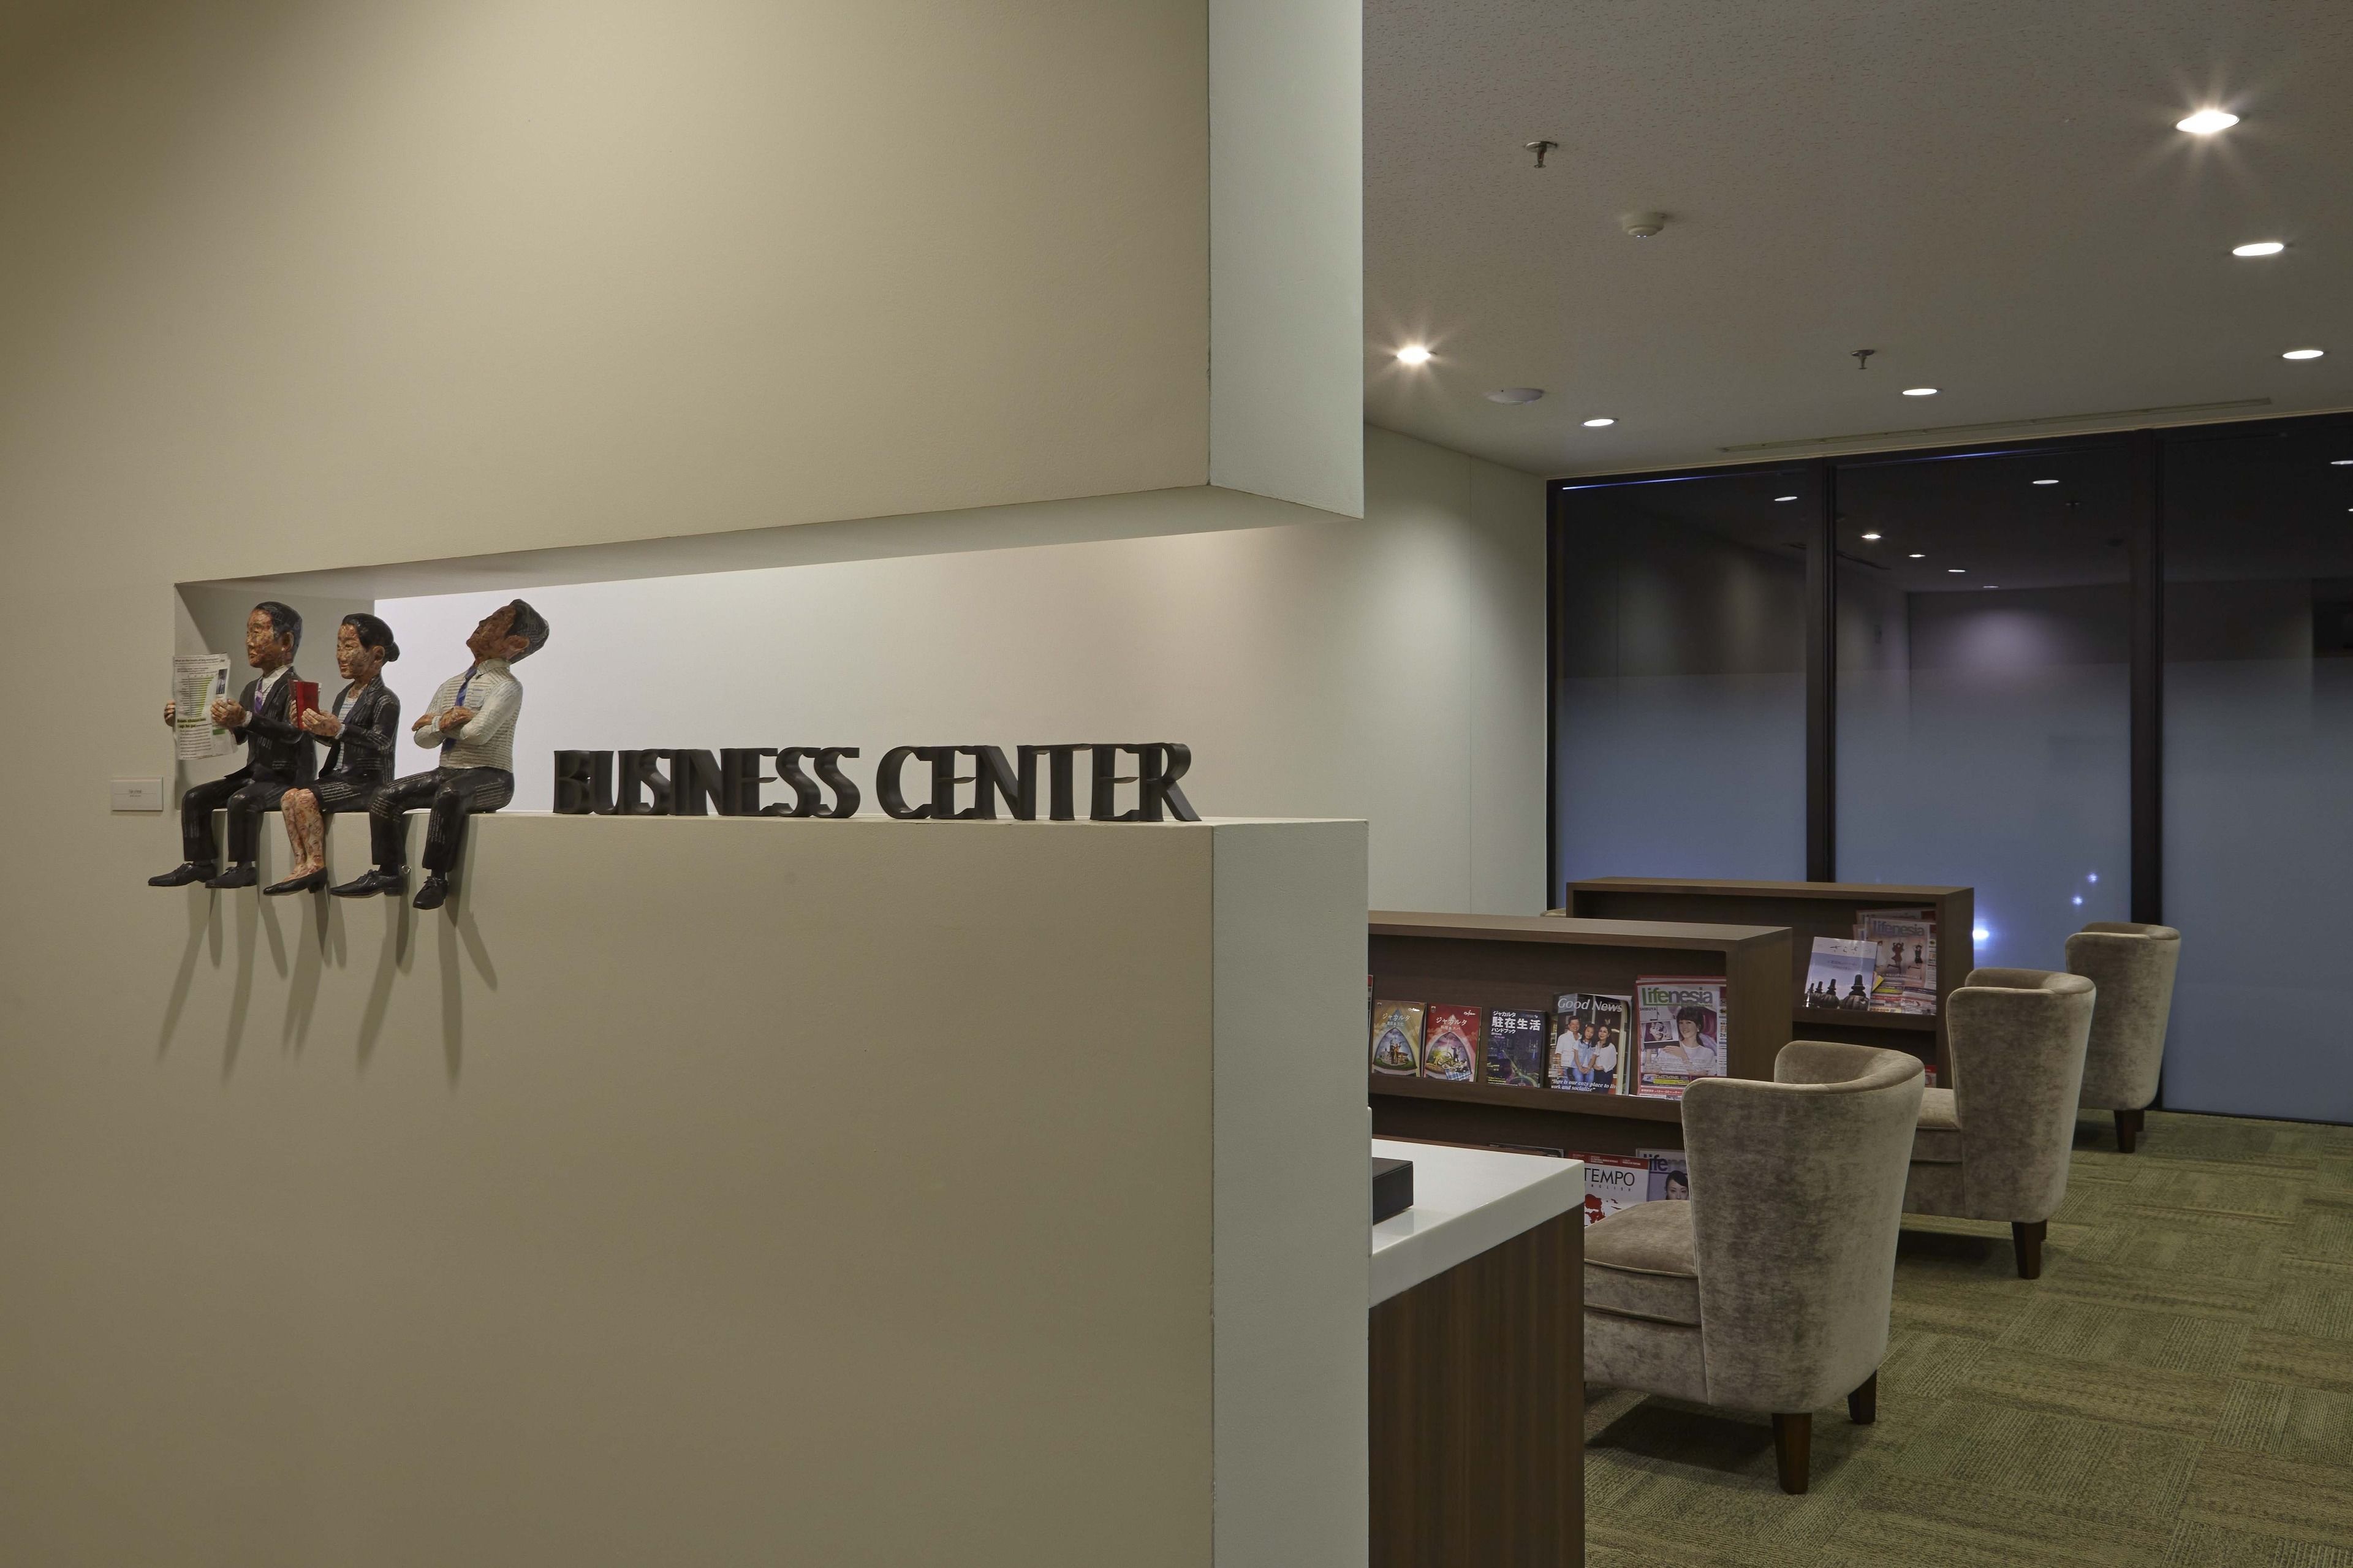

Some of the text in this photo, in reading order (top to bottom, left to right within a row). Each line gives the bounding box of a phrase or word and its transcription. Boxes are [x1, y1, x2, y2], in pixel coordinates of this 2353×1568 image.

[553, 743, 1202, 822] BUSINESS CENTER
[1558, 998, 1623, 1012] Good News
[1382, 1013, 1411, 1022] ジャカルタ
[1436, 1017, 1467, 1026] ジャカルタ
[1491, 1016, 1541, 1031] 駐在生活
[1585, 1167, 1635, 1186] TEMPO
